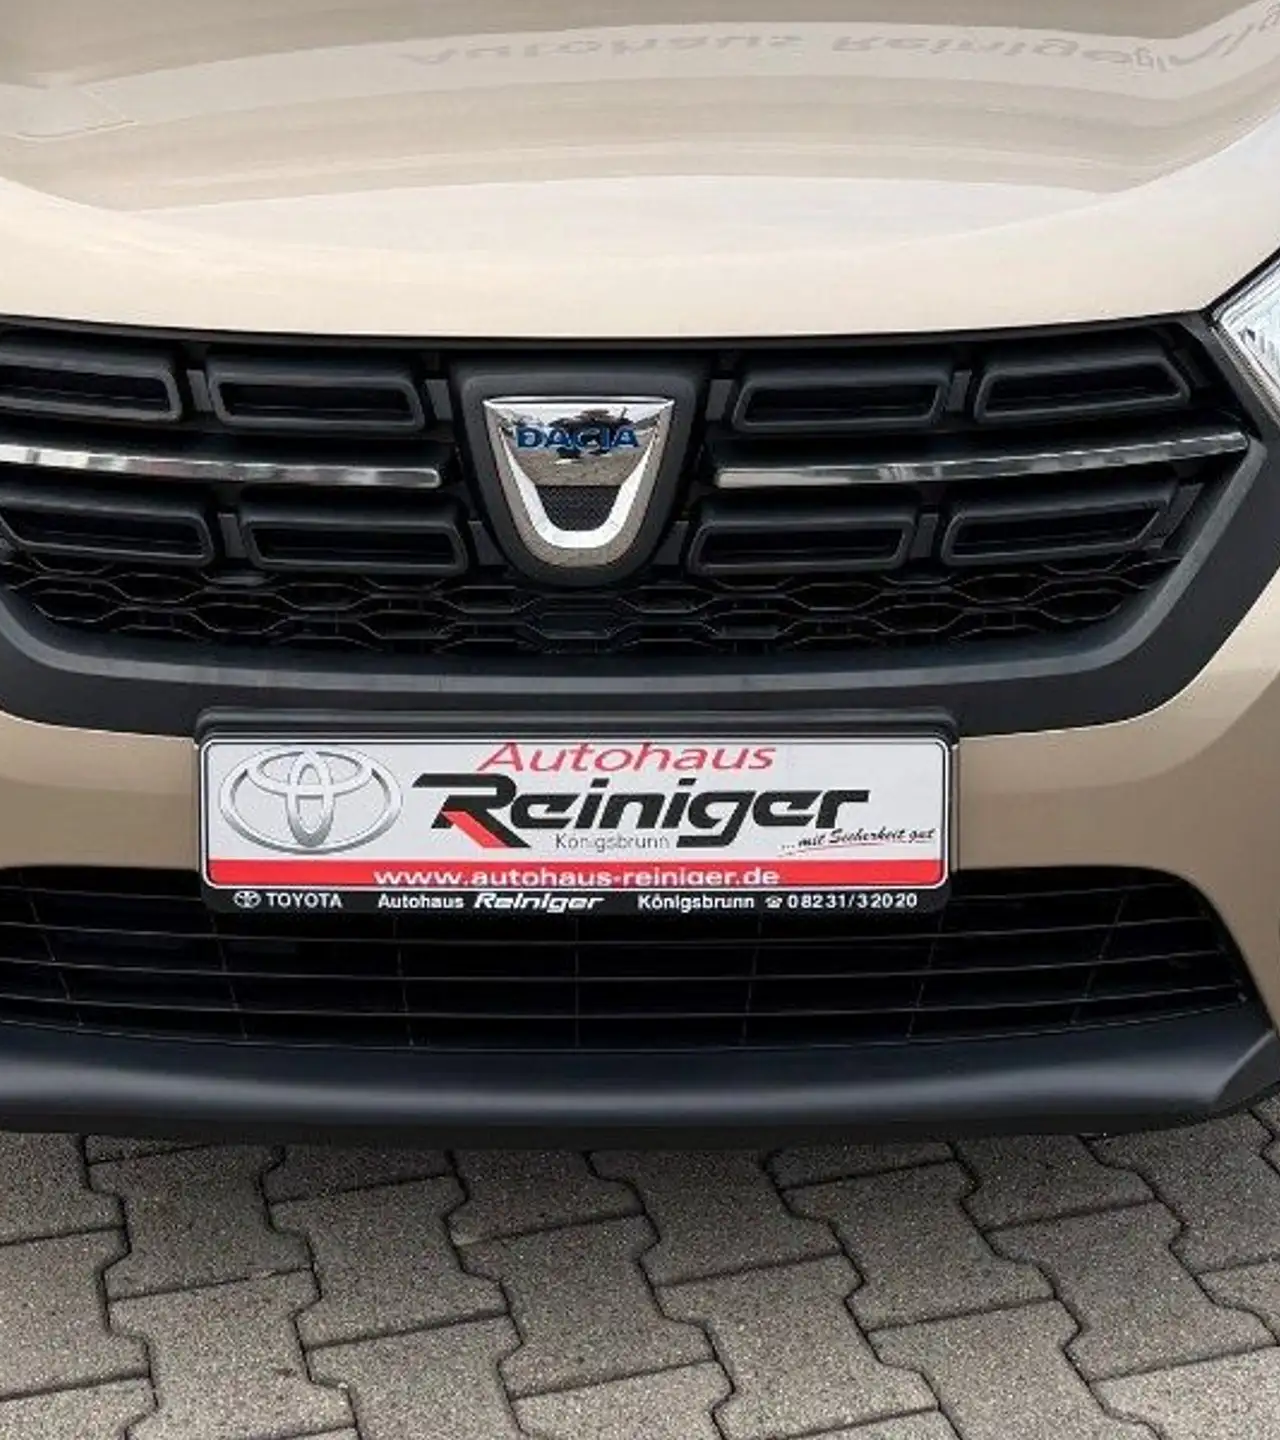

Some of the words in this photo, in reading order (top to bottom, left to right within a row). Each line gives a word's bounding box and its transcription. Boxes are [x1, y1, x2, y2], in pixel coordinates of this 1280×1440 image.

[515, 427, 640, 449] DACIA
[475, 741, 777, 773] Autohaus
[412, 773, 870, 849] Reiniger
[373, 867, 781, 888] www.autohaus-reiniger.de
[266, 892, 343, 909] TOYOTA
[377, 892, 465, 910] Autohaus
[473, 891, 606, 914] Reiniger
[637, 892, 756, 913] Königsbrunn
